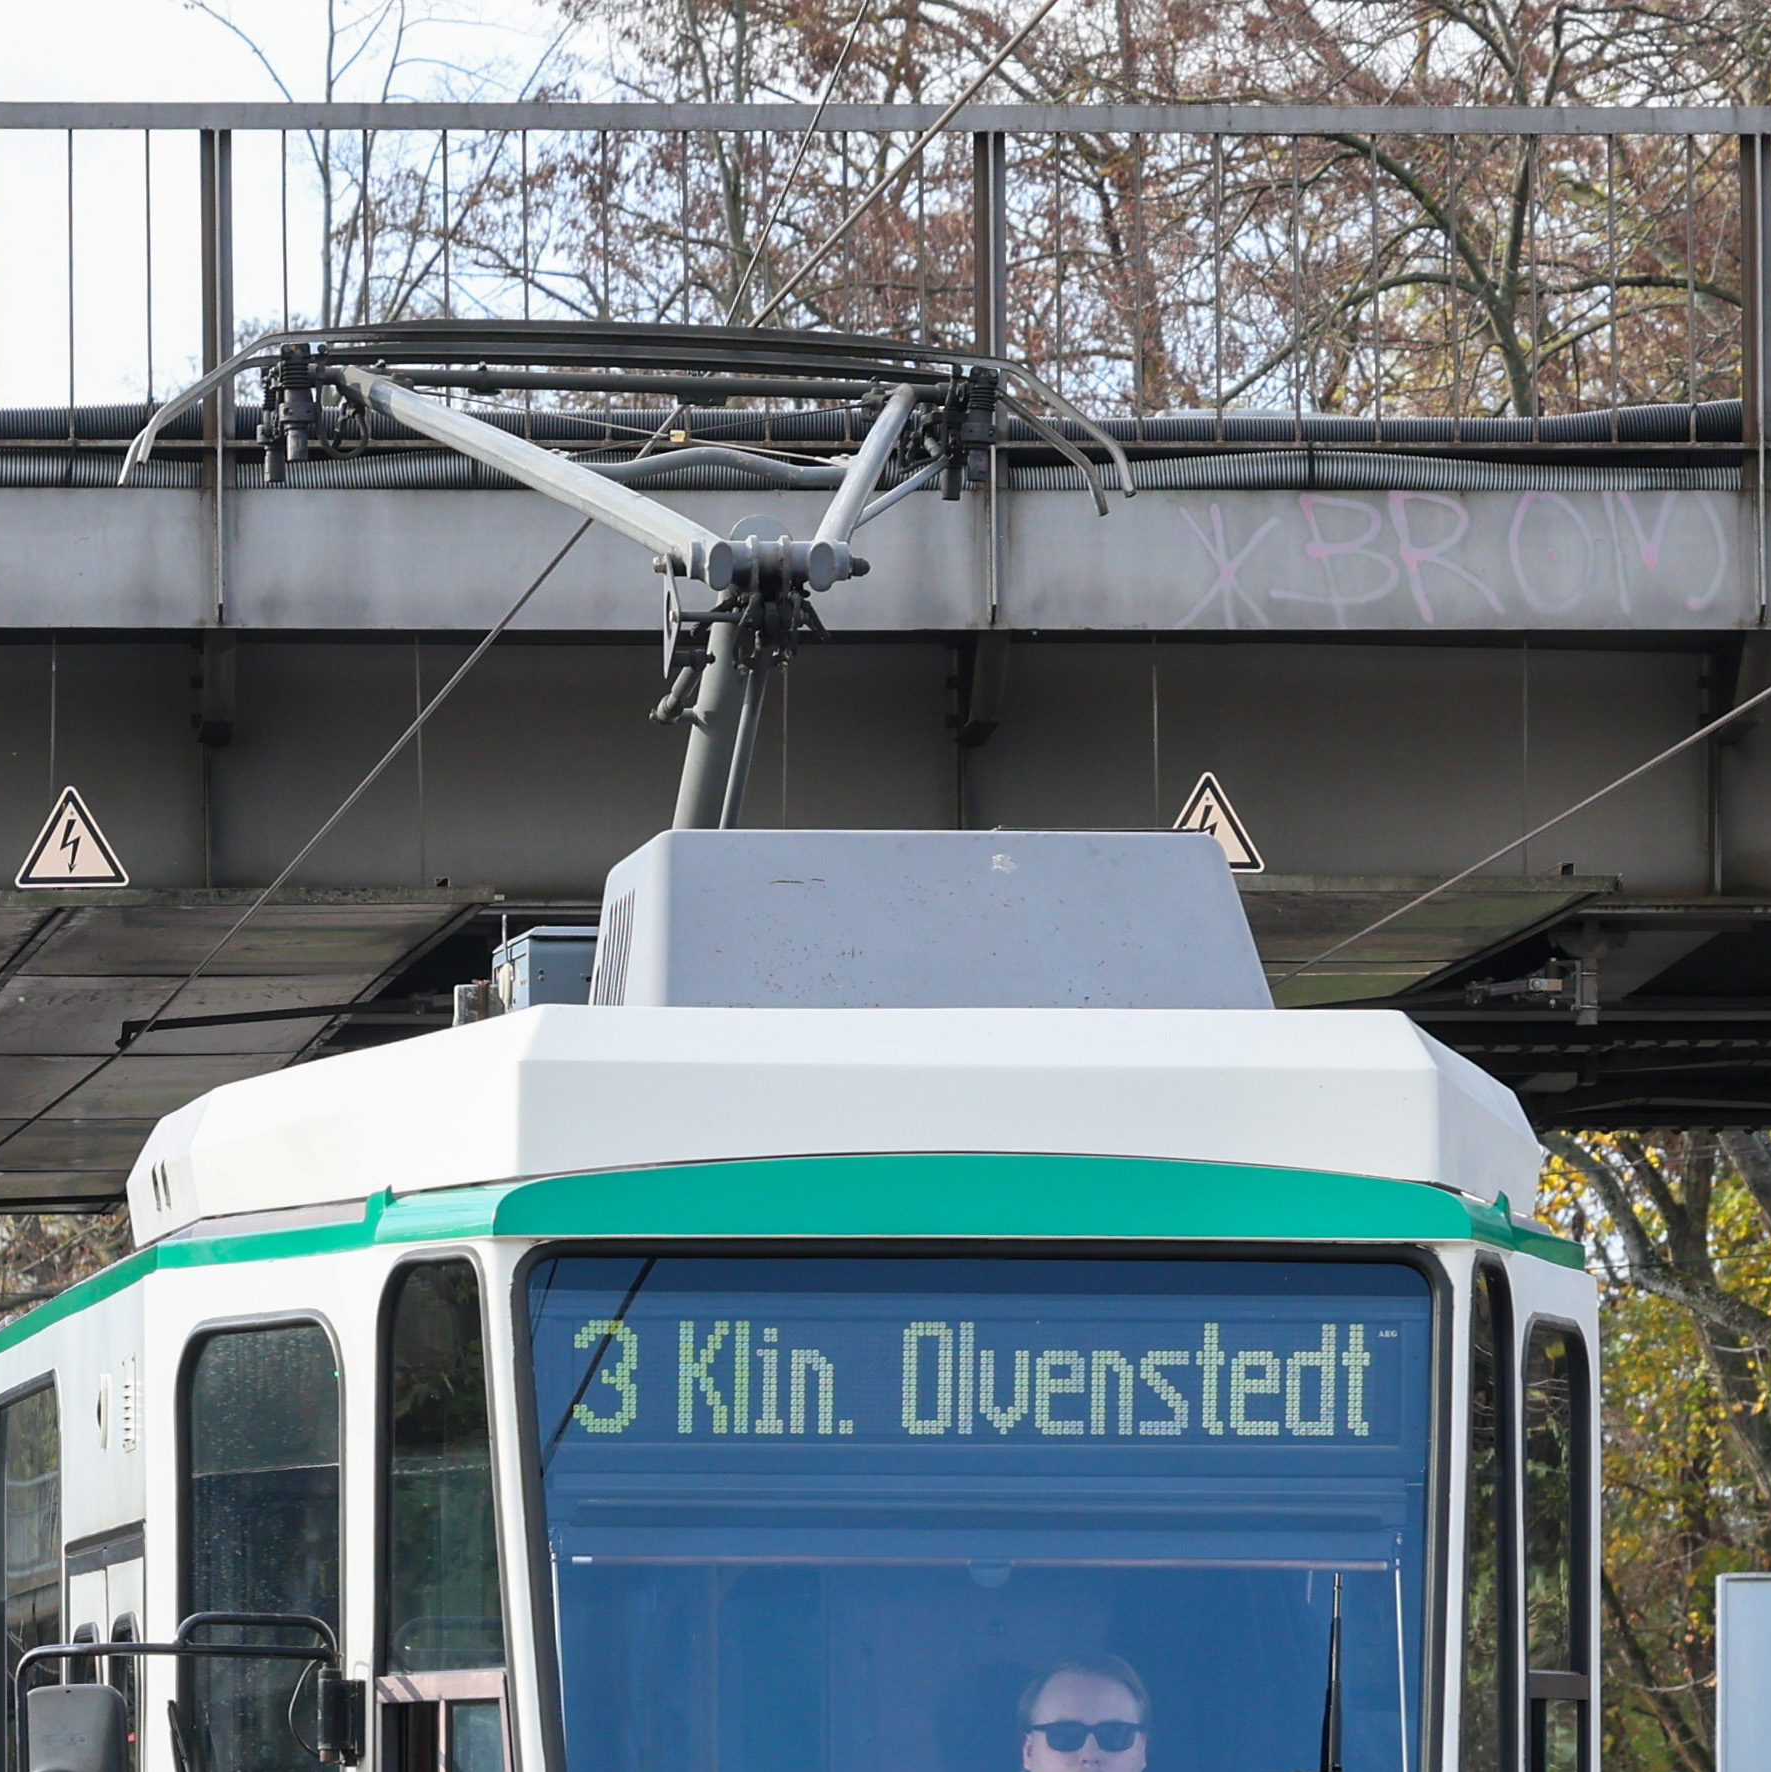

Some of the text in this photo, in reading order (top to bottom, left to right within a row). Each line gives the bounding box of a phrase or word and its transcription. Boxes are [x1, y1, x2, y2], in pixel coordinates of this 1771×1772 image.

[1378, 1330, 1397, 1338] AEG
[573, 1320, 1371, 1436] 3 Klin. Olvenstedt
